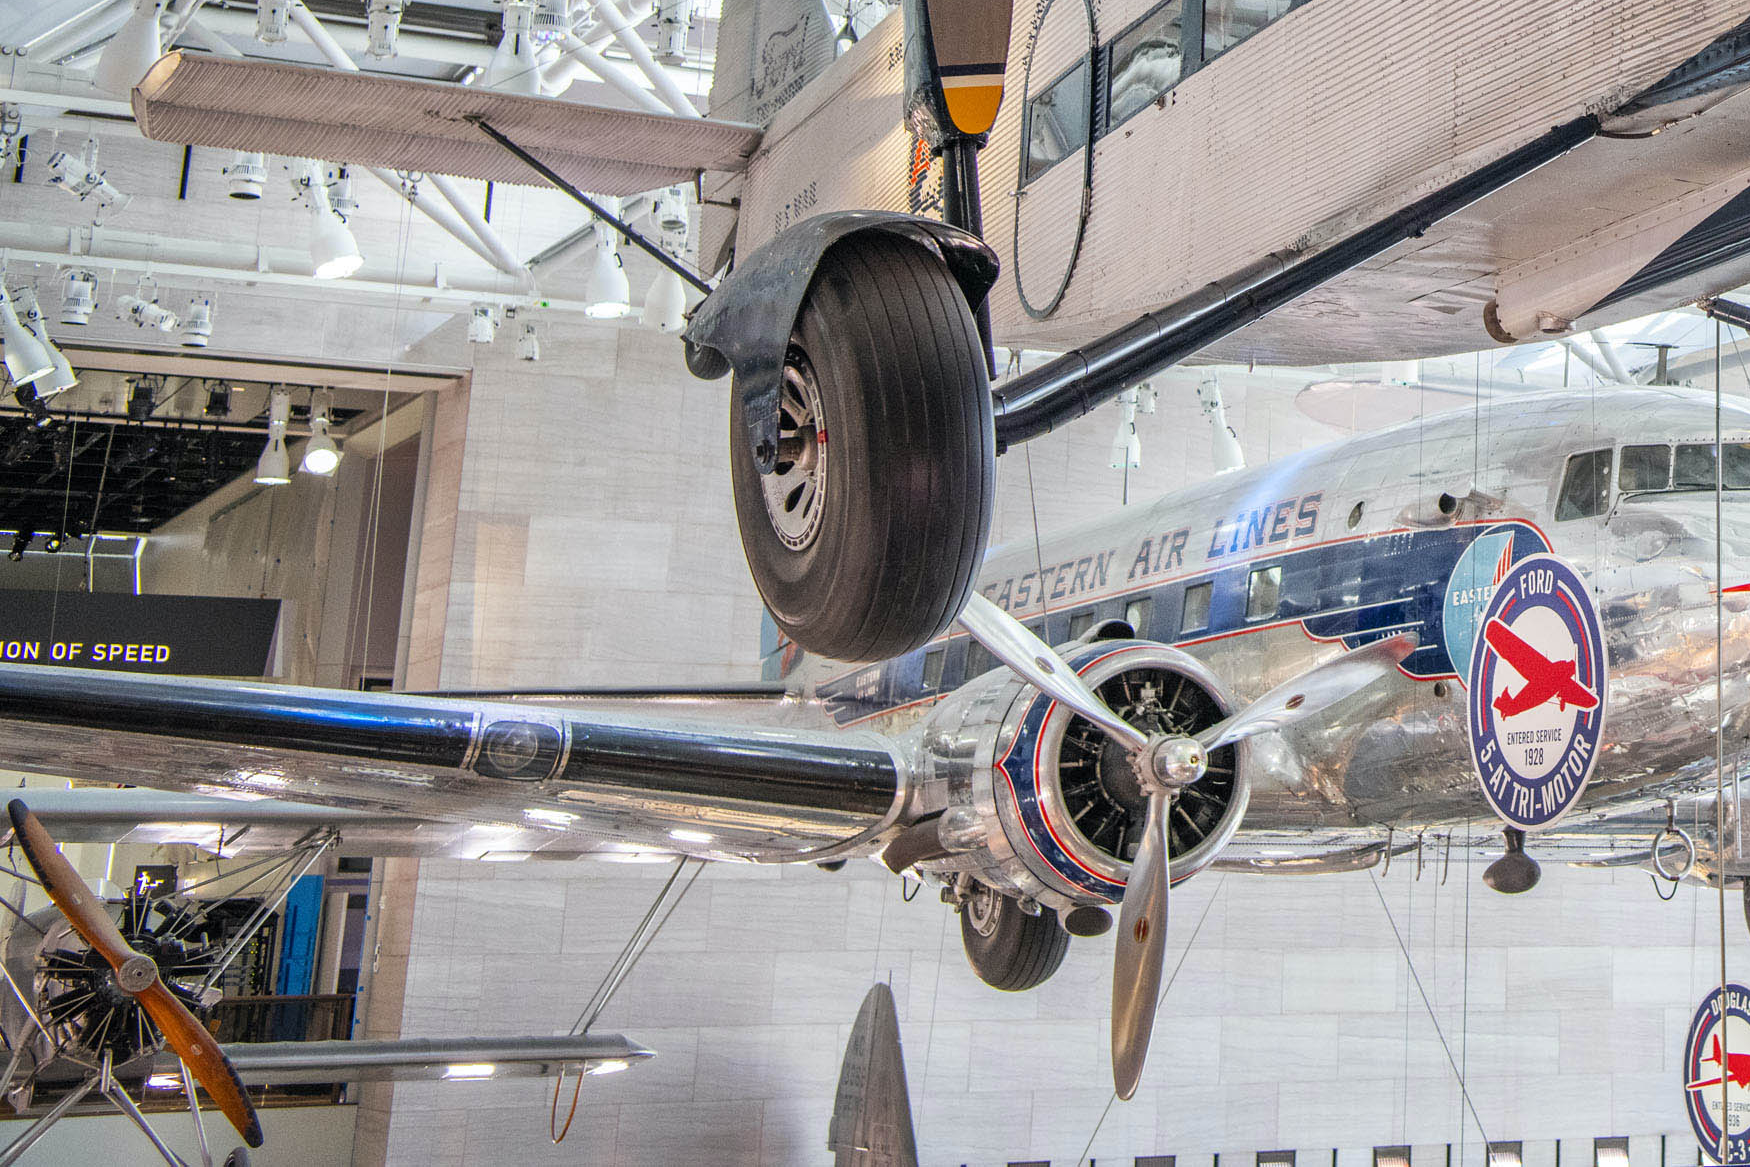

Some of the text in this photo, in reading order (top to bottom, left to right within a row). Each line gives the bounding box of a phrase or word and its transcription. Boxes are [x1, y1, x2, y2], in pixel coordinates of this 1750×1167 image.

[1128, 527, 1190, 582] AIR
[1207, 490, 1325, 562] LINES
[1519, 569, 1554, 599] FORD
[51, 642, 83, 661] OF
[92, 644, 170, 663] SPEED
[1507, 728, 1562, 746] ENTERED SERVICE
[1524, 747, 1544, 766] 1928
[1480, 734, 1592, 819] 5-AT TRI-MOTOR
